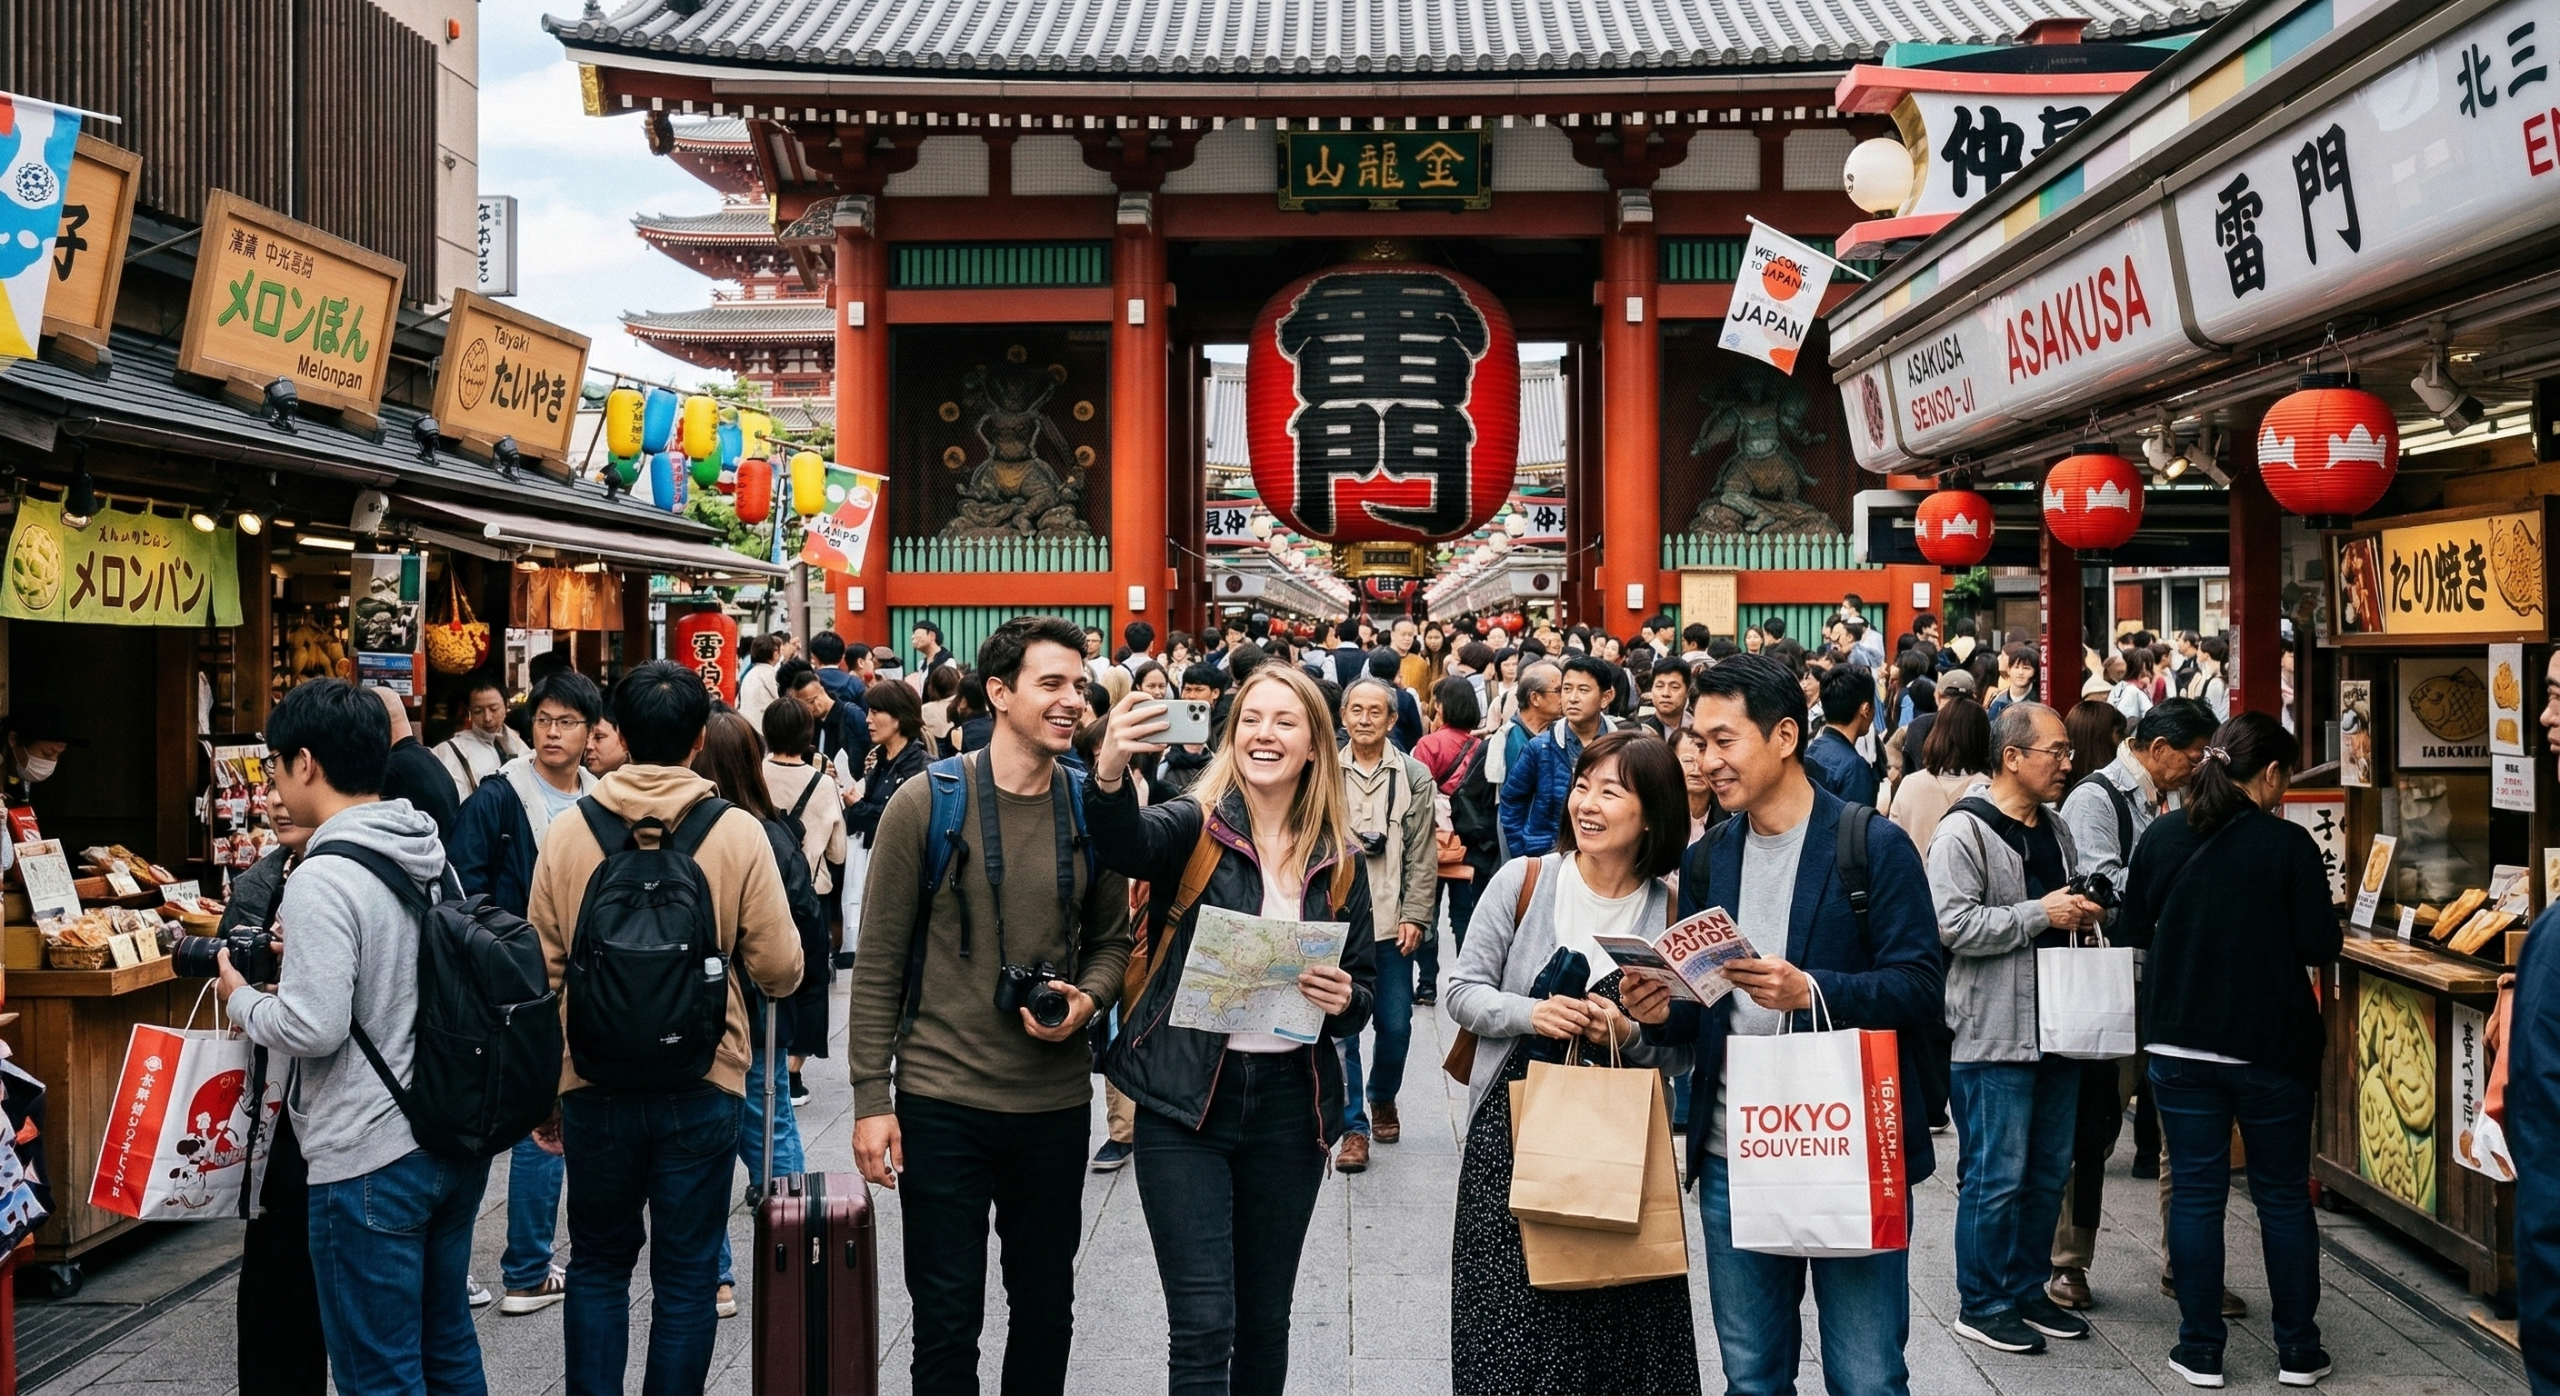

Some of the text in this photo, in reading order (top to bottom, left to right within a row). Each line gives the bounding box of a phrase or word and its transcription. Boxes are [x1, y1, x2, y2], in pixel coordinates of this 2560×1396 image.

[2523, 106, 2560, 176] E
[2215, 123, 2361, 300] 雷門
[1751, 260, 1762, 271] TO
[1754, 245, 1809, 277] WELCOME
[494, 325, 531, 353] Taiyaki
[1731, 302, 1804, 343] JAPAN
[2005, 254, 2152, 385] ASAKUSA
[297, 354, 363, 390] Melonpan
[1906, 333, 1965, 388] ASAKUSA
[490, 355, 567, 423] たいやき
[1911, 376, 1976, 432] SENSO-JI
[69, 551, 205, 614] メロンパン
[1662, 913, 1729, 954] JAPAN
[1671, 925, 1738, 962] GUIDE
[1740, 1102, 1851, 1134] TOKYO
[1740, 1137, 1851, 1159] SOUVENIR
